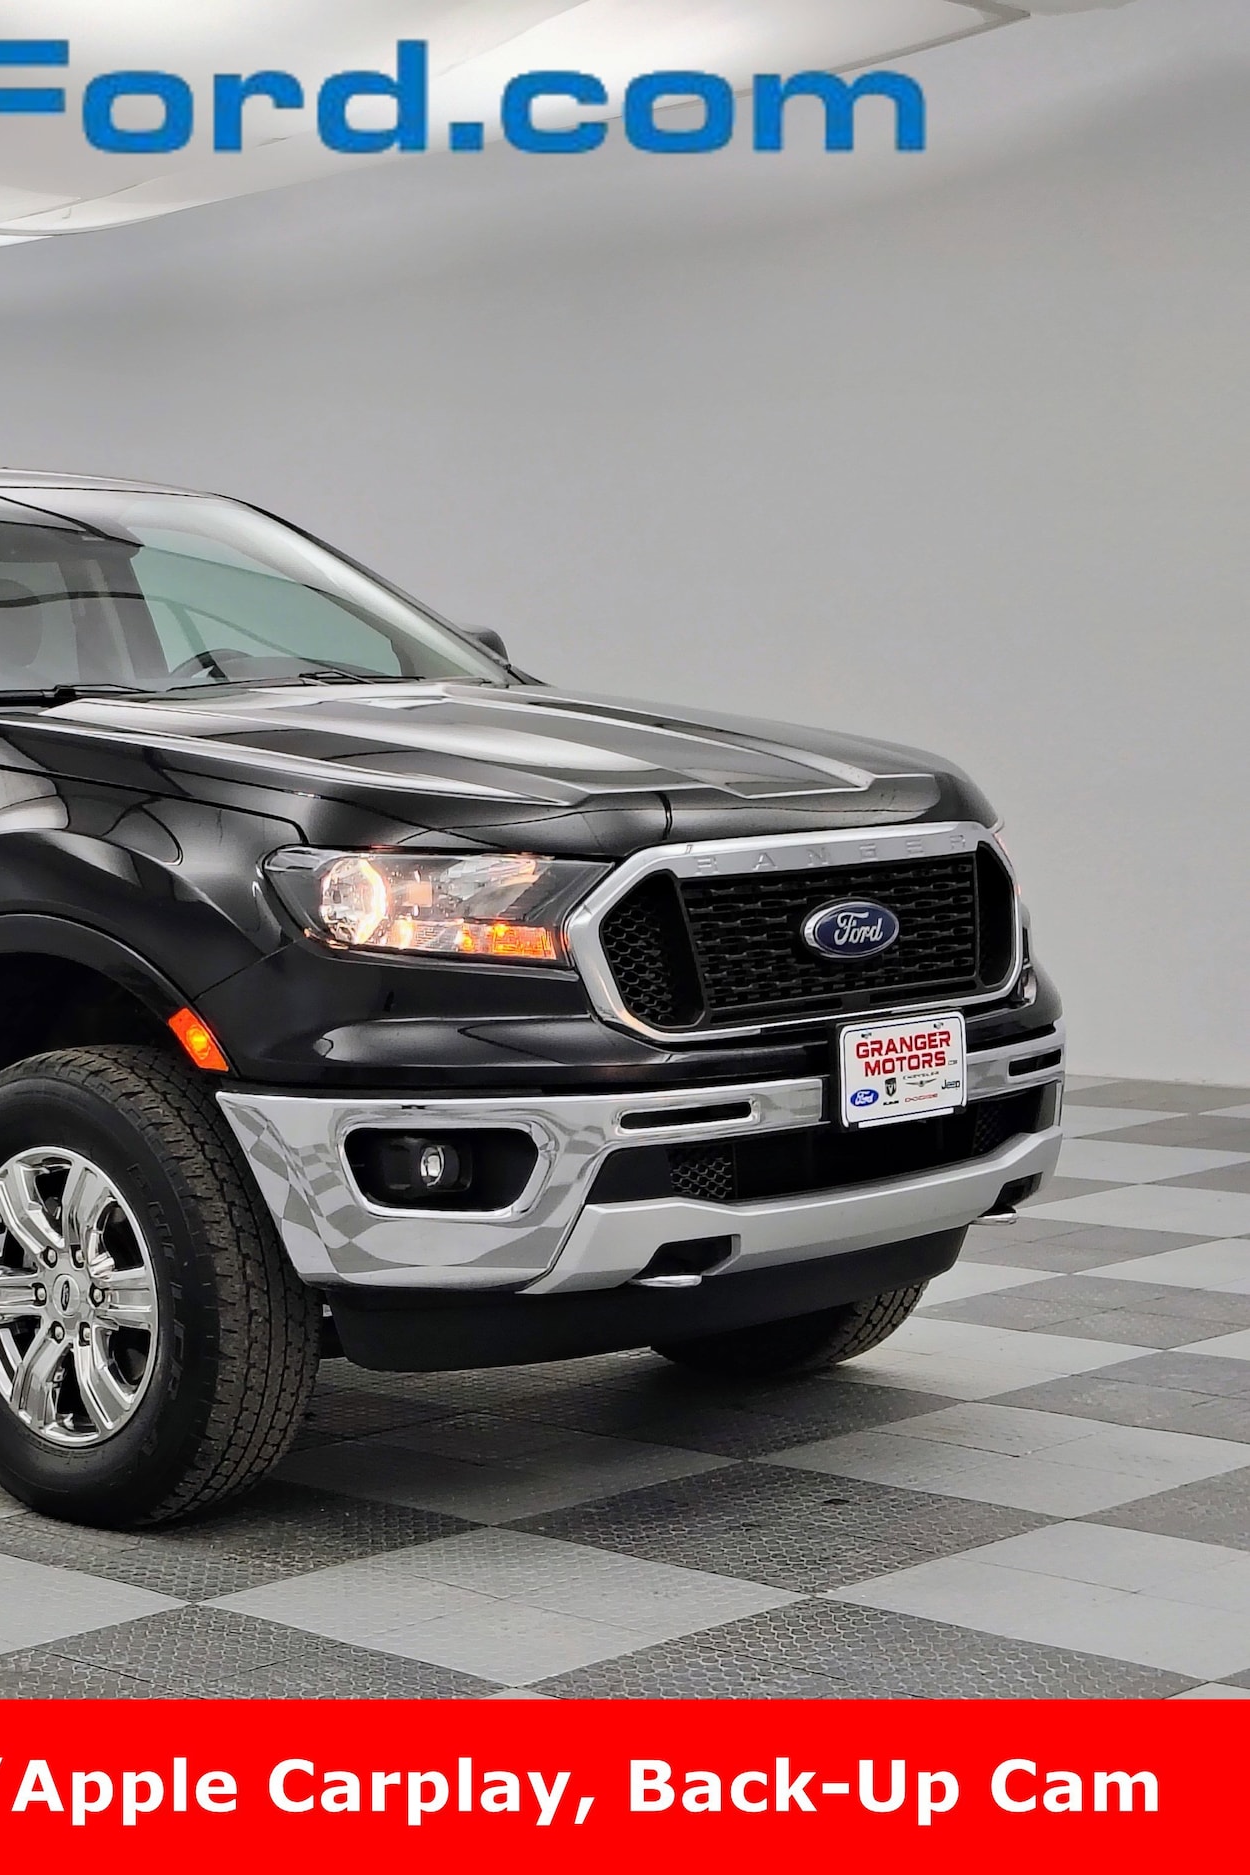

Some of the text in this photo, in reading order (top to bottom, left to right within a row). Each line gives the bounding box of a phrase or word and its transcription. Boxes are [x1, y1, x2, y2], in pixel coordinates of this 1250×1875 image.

[833, 911, 884, 946] Ford
[855, 1030, 951, 1059] GRANGER
[864, 1051, 946, 1077] MOTORS
[854, 1090, 875, 1105] Ford
